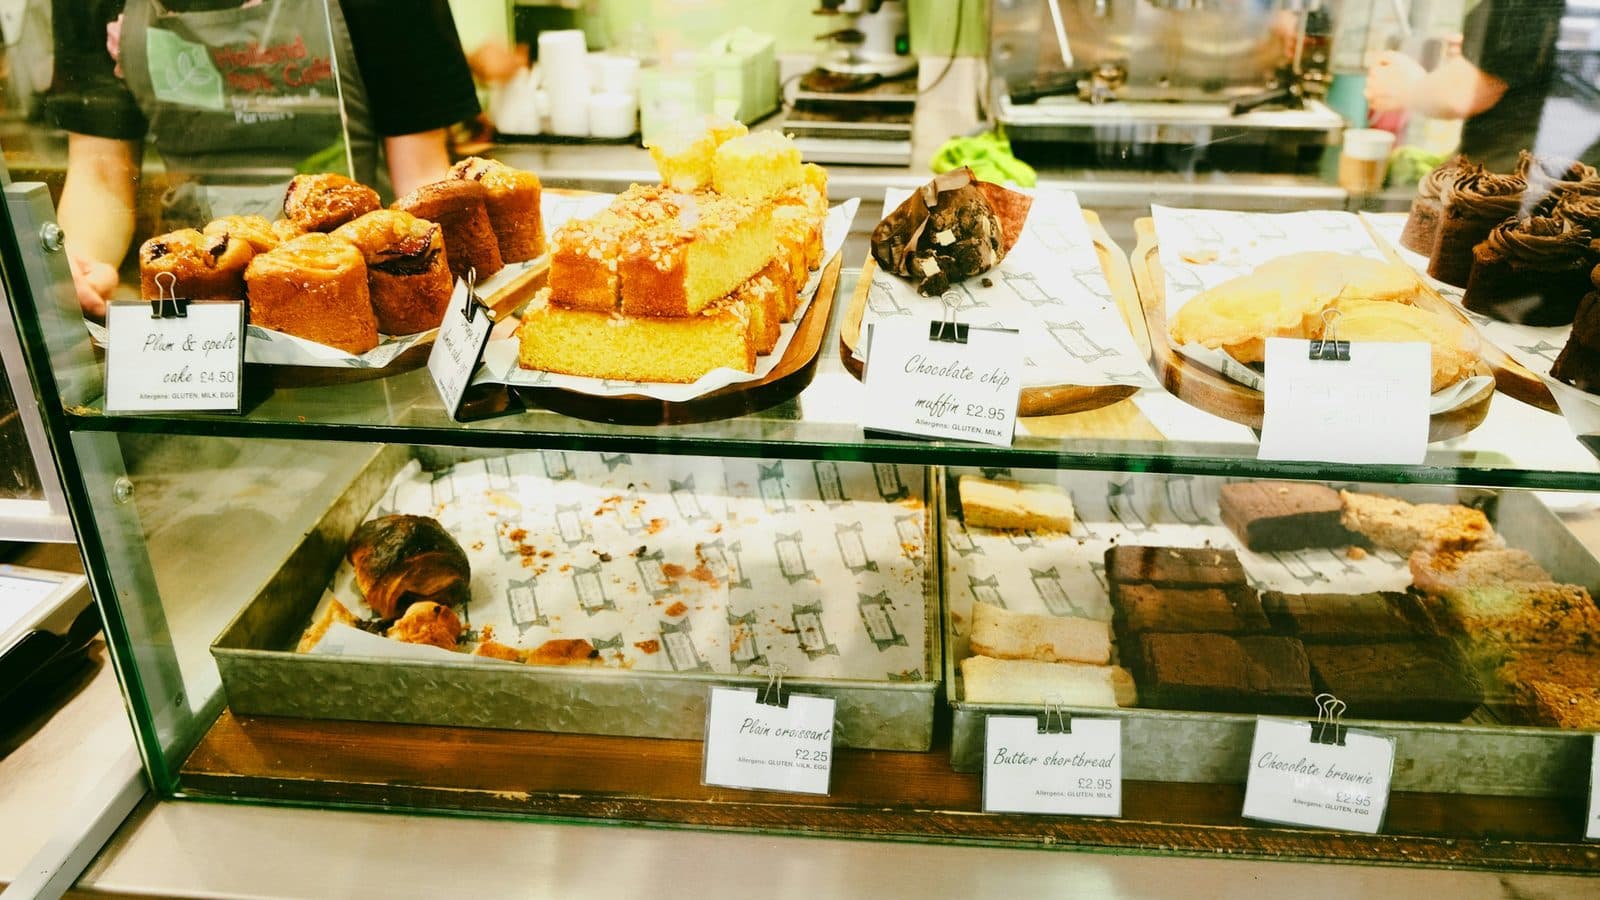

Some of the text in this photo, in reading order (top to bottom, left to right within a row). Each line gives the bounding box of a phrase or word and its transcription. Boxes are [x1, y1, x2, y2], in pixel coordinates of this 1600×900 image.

[142, 332, 236, 358] Plum & spelt
[162, 365, 235, 383] cake £4.50
[904, 353, 1011, 393] Chocolate chip
[220, 391, 235, 399] EGG
[915, 392, 1006, 421] muffin £2.95
[915, 418, 949, 430] Allergens:
[984, 428, 1003, 437] MILK
[739, 717, 831, 741] Plain croissant
[795, 748, 829, 762] £2.25
[993, 747, 1116, 768] Butter shortbread
[813, 763, 828, 771] EGG
[1257, 752, 1373, 784] Chocolate brownie
[1078, 777, 1113, 790] £2.95
[1336, 792, 1371, 806] £2.95
[1354, 807, 1370, 816] EGG
